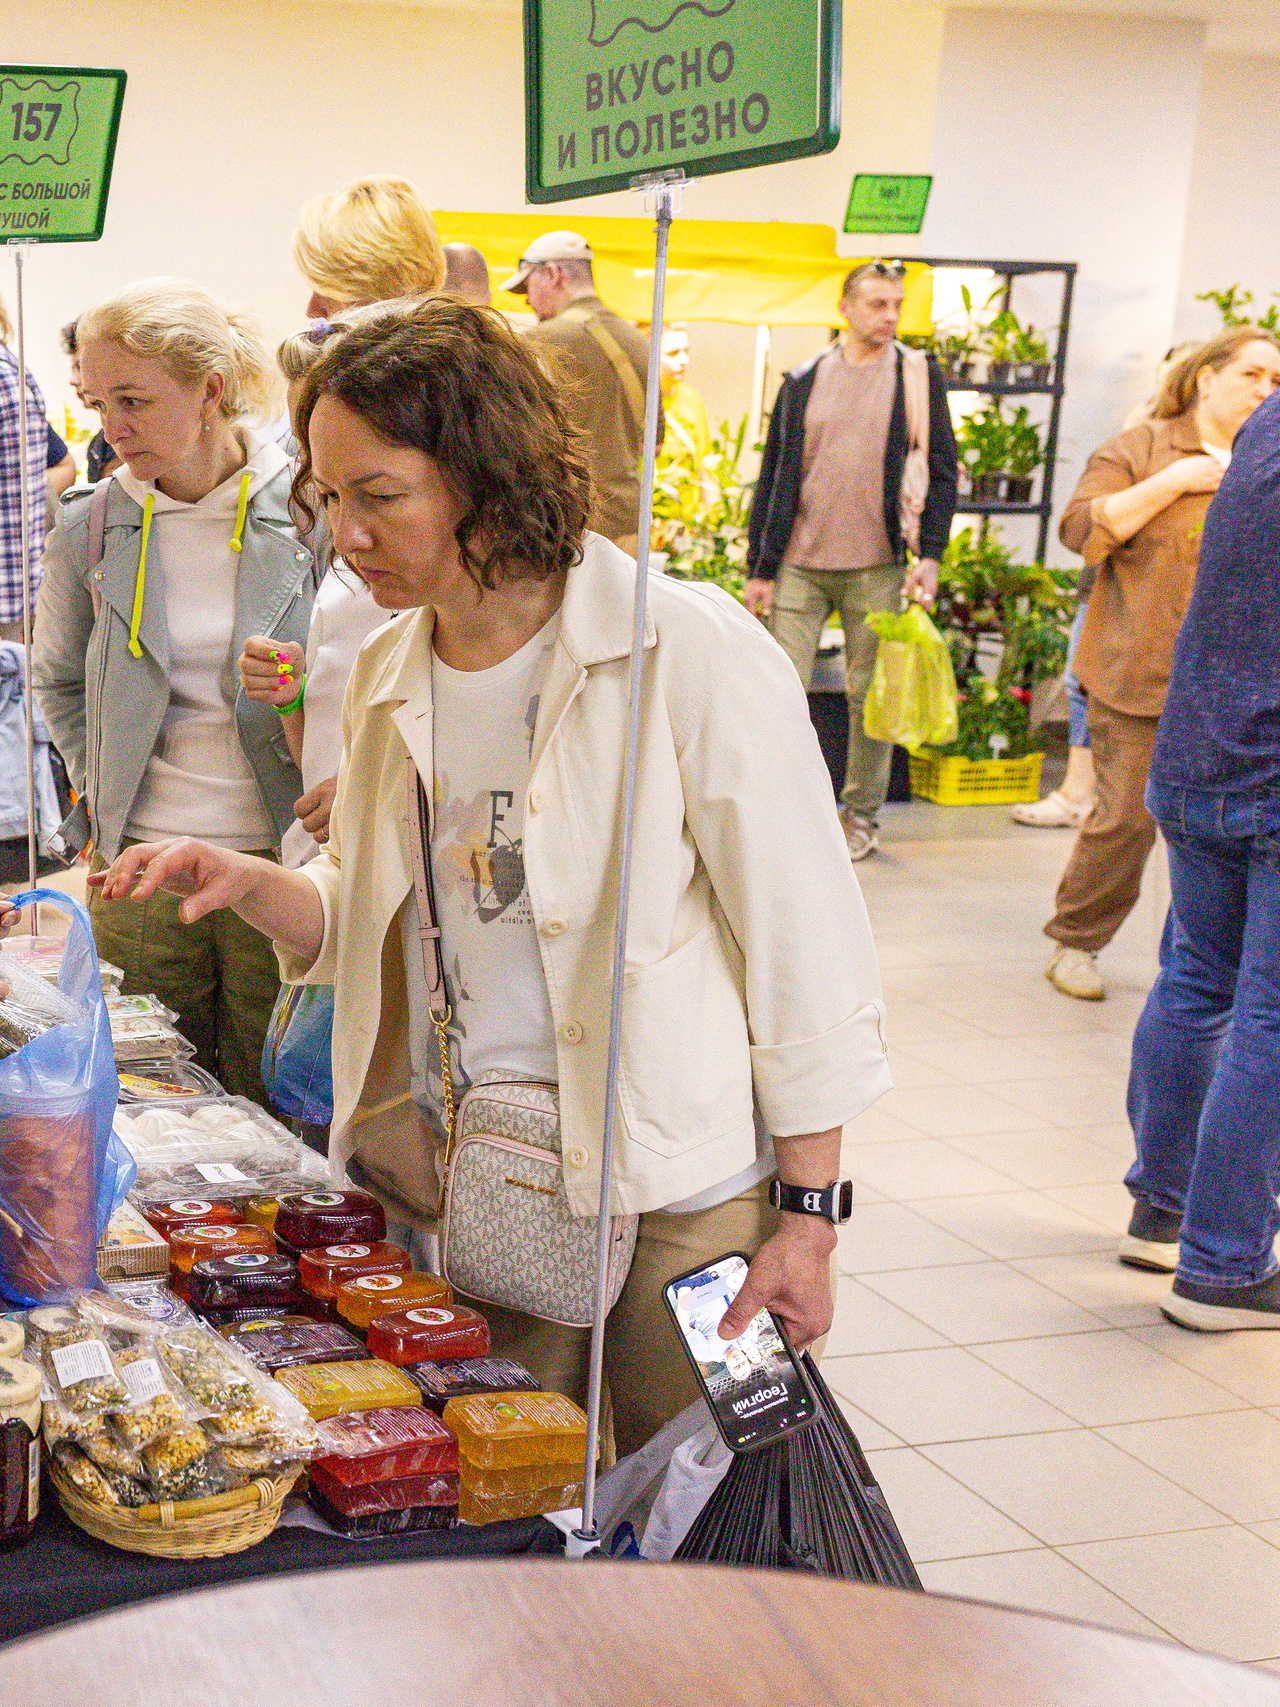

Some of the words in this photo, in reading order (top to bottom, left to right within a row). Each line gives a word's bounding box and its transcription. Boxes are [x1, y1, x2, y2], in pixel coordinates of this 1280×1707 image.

[586, 40, 735, 113] ВКУСНО
[10, 101, 62, 142] 157
[558, 132, 577, 172] И
[591, 92, 770, 165] ПОЛЕЗНО
[11, 177, 91, 202] БОЛЬШОЙ
[731, 1381, 789, 1416] Георгий
